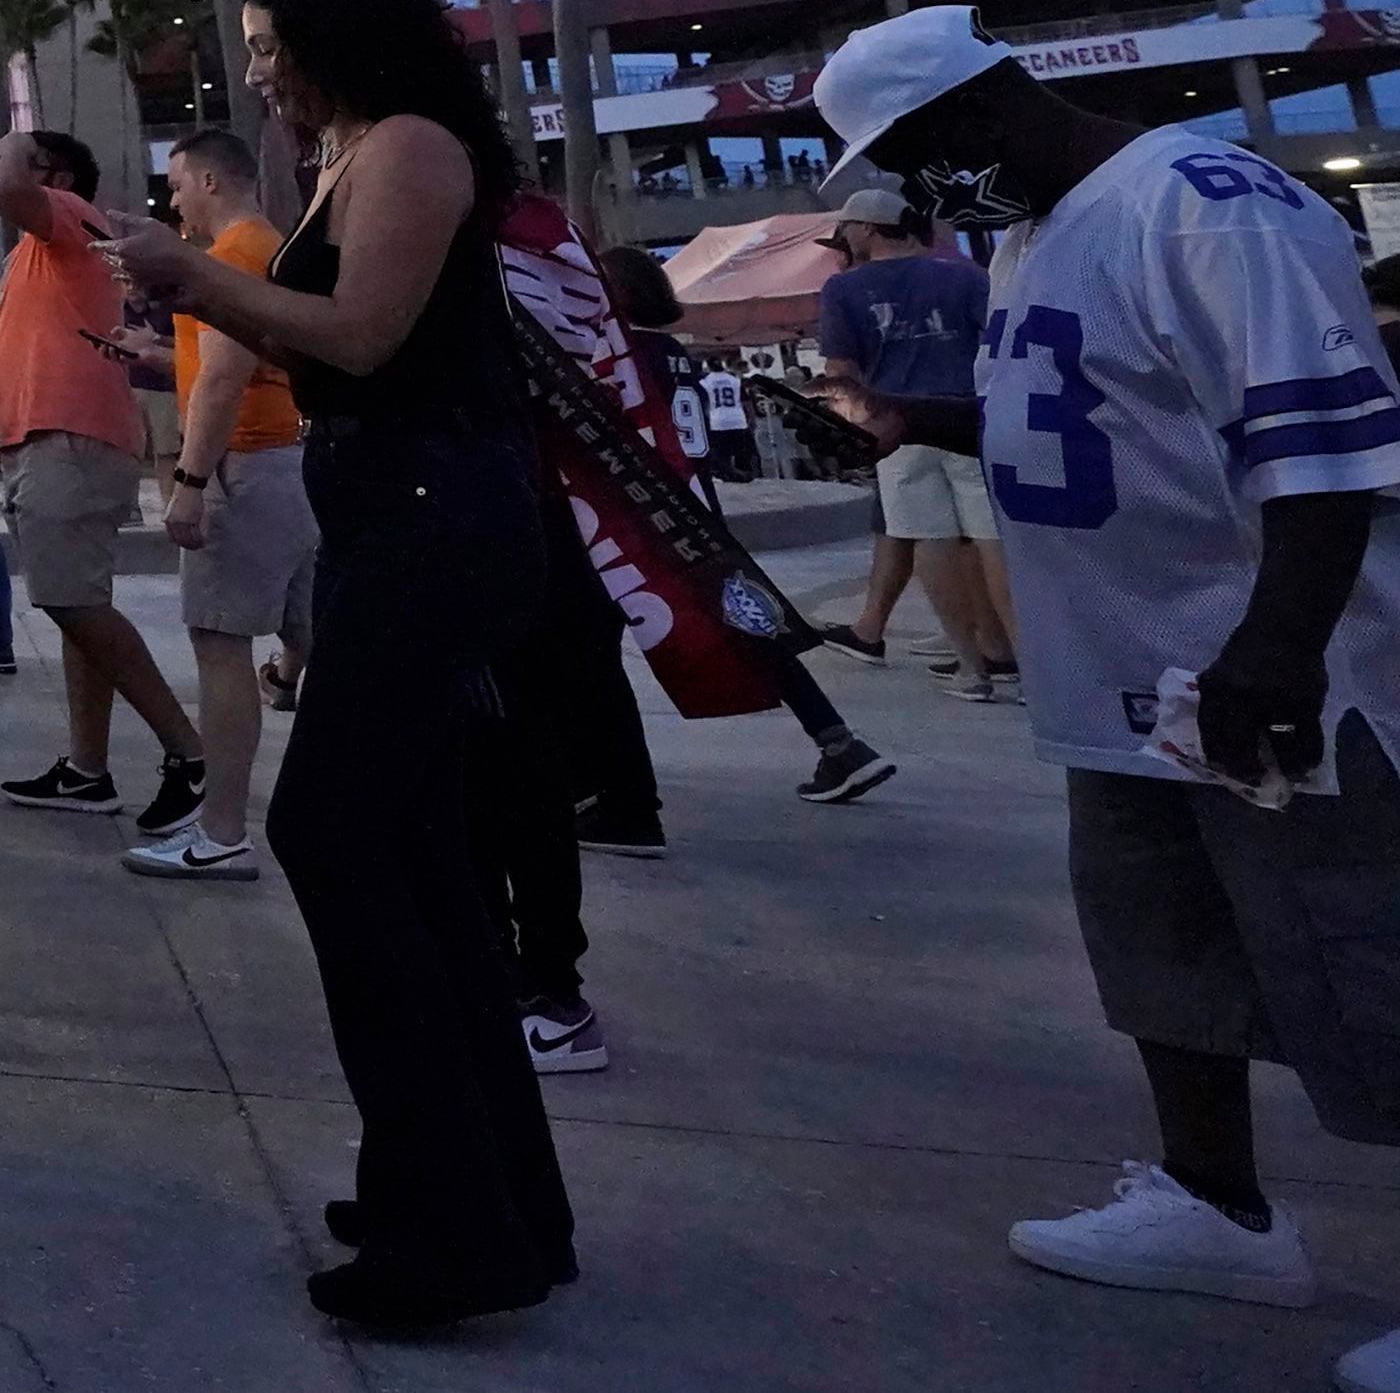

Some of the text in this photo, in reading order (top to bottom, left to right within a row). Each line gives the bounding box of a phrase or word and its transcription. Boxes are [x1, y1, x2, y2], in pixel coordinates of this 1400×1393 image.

[1014, 38, 1140, 73] CCANEERS
[1169, 153, 1305, 211] 63
[671, 385, 710, 459] 9
[977, 304, 1118, 530] 3
